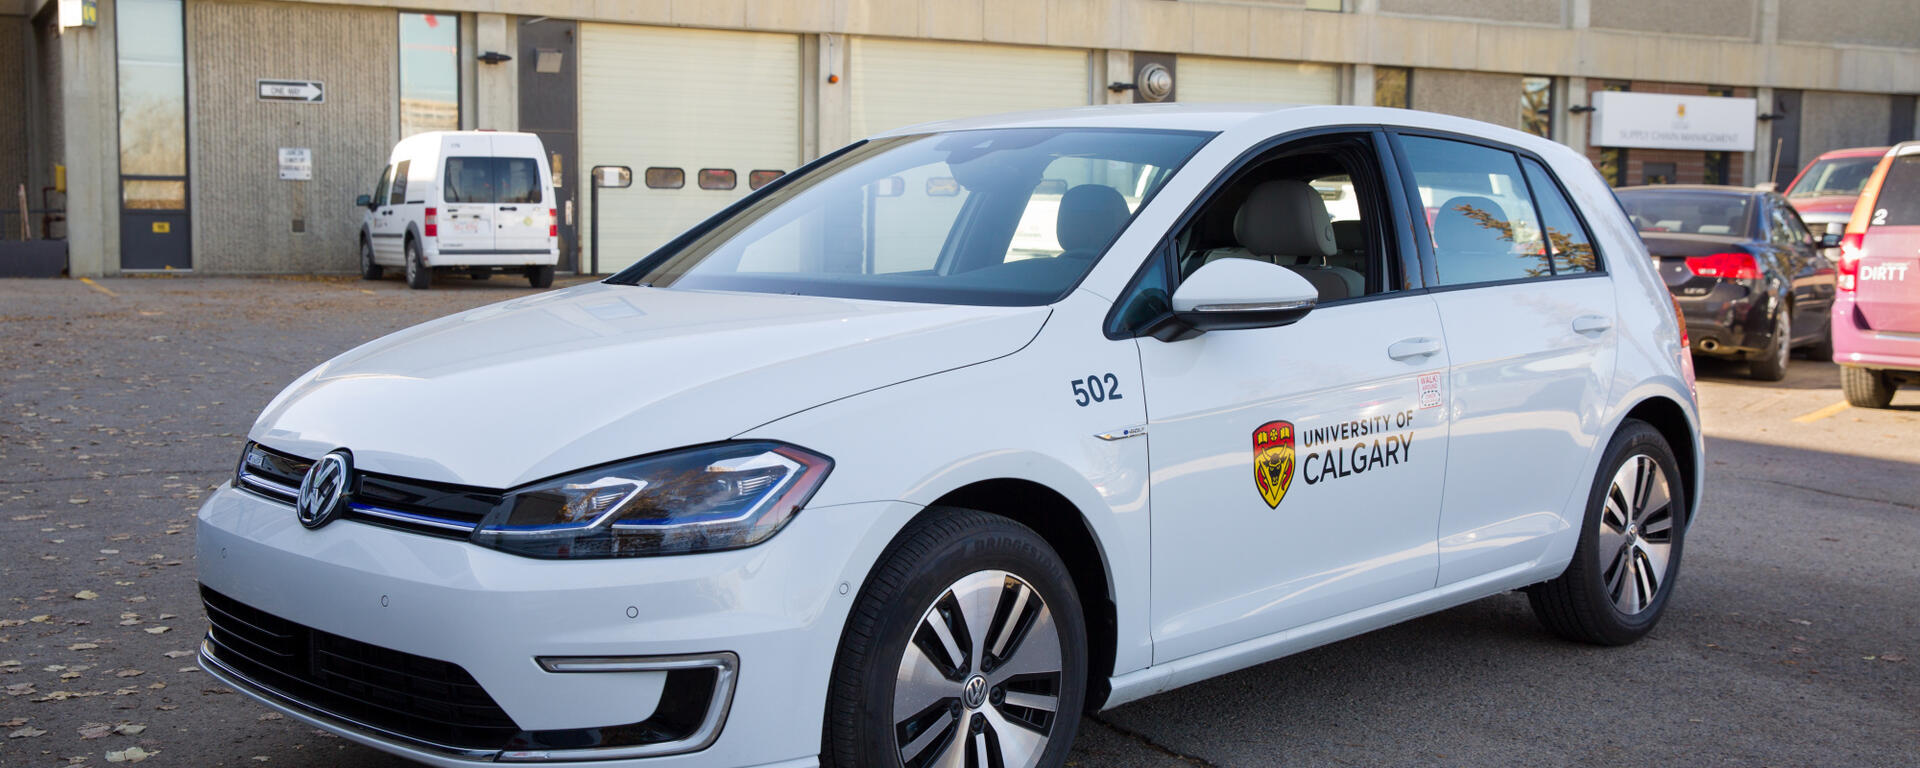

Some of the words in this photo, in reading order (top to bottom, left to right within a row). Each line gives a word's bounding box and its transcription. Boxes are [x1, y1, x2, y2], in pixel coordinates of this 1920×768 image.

[270, 86, 284, 95] ONE
[287, 87, 301, 97] WAY
[1619, 129, 1648, 140] SUPPLY
[1651, 131, 1679, 142] CHAIN
[1681, 132, 1739, 144] MANAGEMENT
[1871, 208, 1889, 225] 2
[1860, 265, 1908, 281] DIRTT
[1071, 372, 1123, 407] 502
[1303, 415, 1392, 448] UNIVERSITY
[1396, 409, 1414, 428] OF
[1303, 431, 1414, 486] CALGARY
